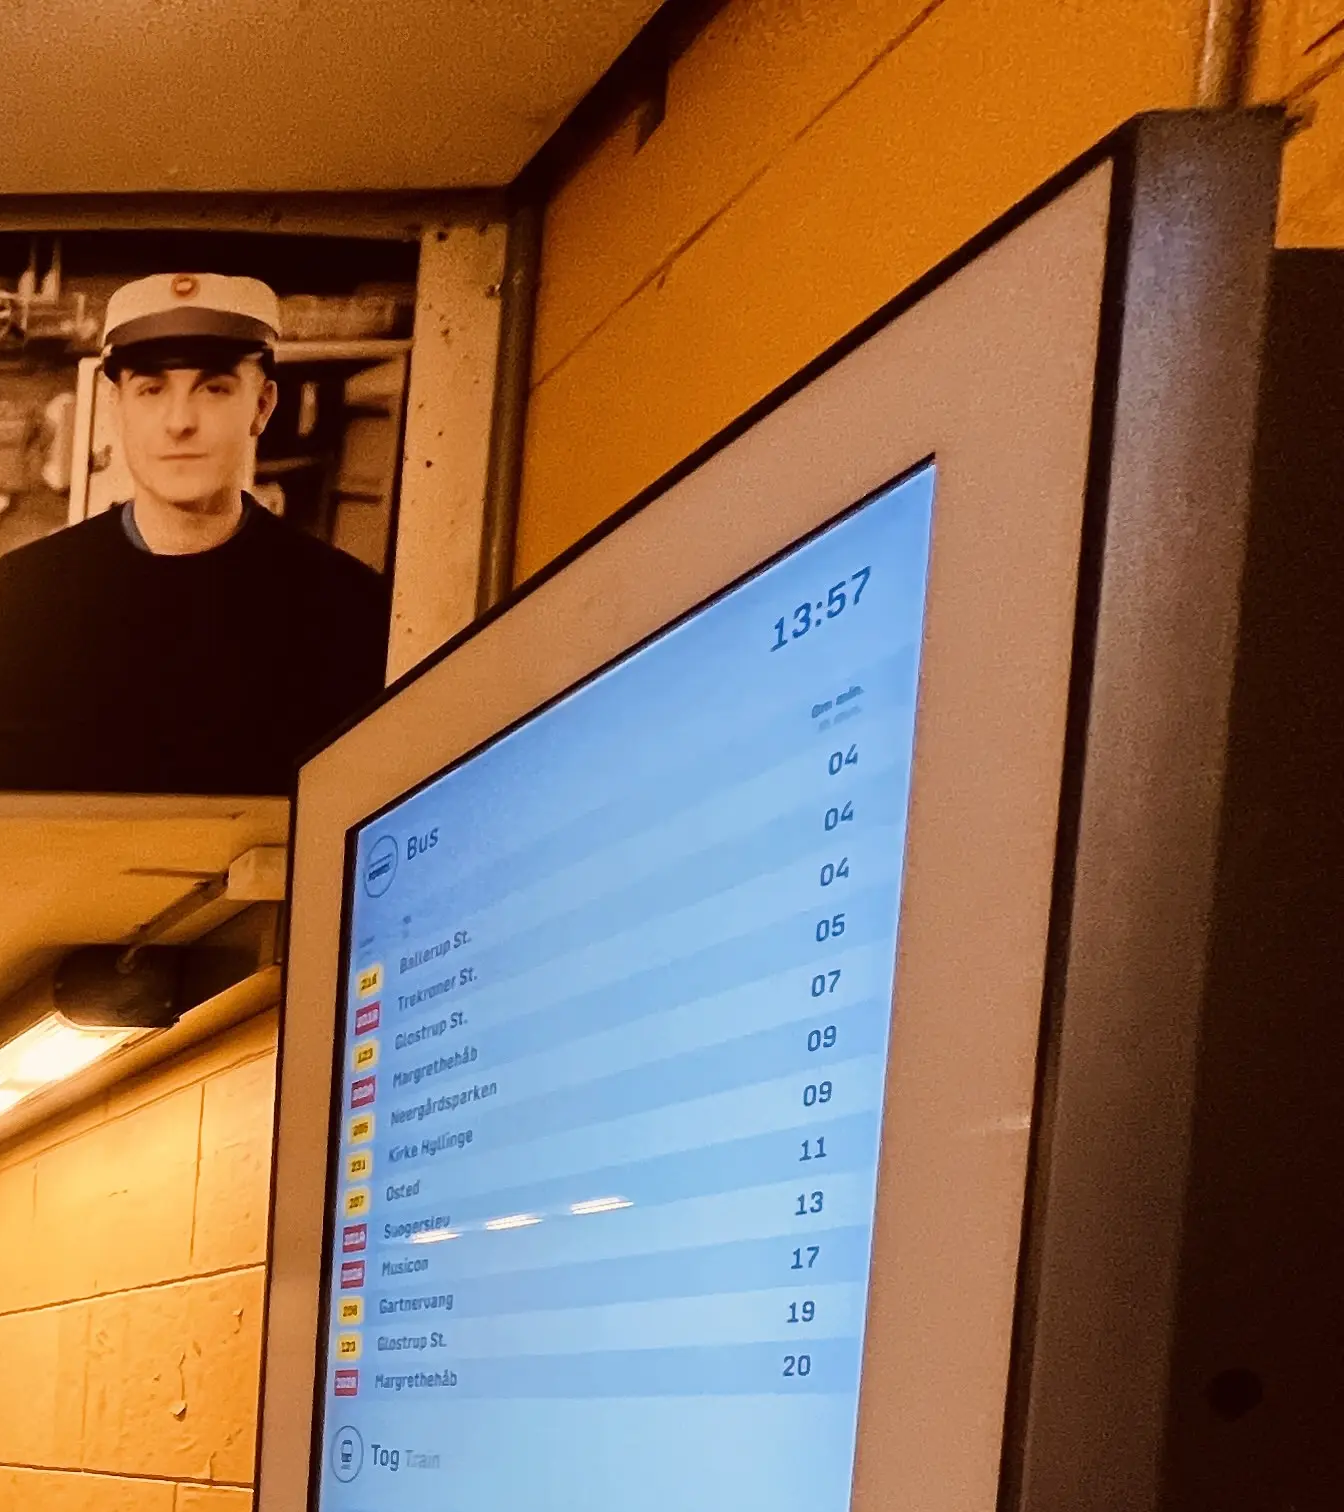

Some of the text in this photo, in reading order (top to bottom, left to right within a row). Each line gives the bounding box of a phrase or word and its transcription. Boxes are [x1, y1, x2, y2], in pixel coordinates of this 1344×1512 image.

[770, 565, 872, 653] 13:57
[828, 743, 859, 776] 04
[824, 799, 854, 832] 04
[407, 827, 439, 861] Bus
[819, 856, 850, 887] 04
[453, 929, 473, 949] St.
[815, 912, 846, 942] 05
[459, 966, 478, 986] St.
[811, 968, 842, 998] 07
[395, 1020, 447, 1051] Glostrup
[449, 1011, 468, 1029] St.
[807, 1024, 838, 1052] 09
[802, 1080, 833, 1107] 09
[798, 1135, 828, 1162] 11
[386, 1179, 421, 1202] Osted
[794, 1190, 824, 1216] 13
[381, 1257, 429, 1277] Musicon
[790, 1245, 821, 1271] 17
[786, 1300, 816, 1324] 19
[377, 1336, 427, 1352] Glostrup
[430, 1331, 447, 1348] St.
[782, 1354, 812, 1378] 20
[370, 1443, 401, 1472] Tog
